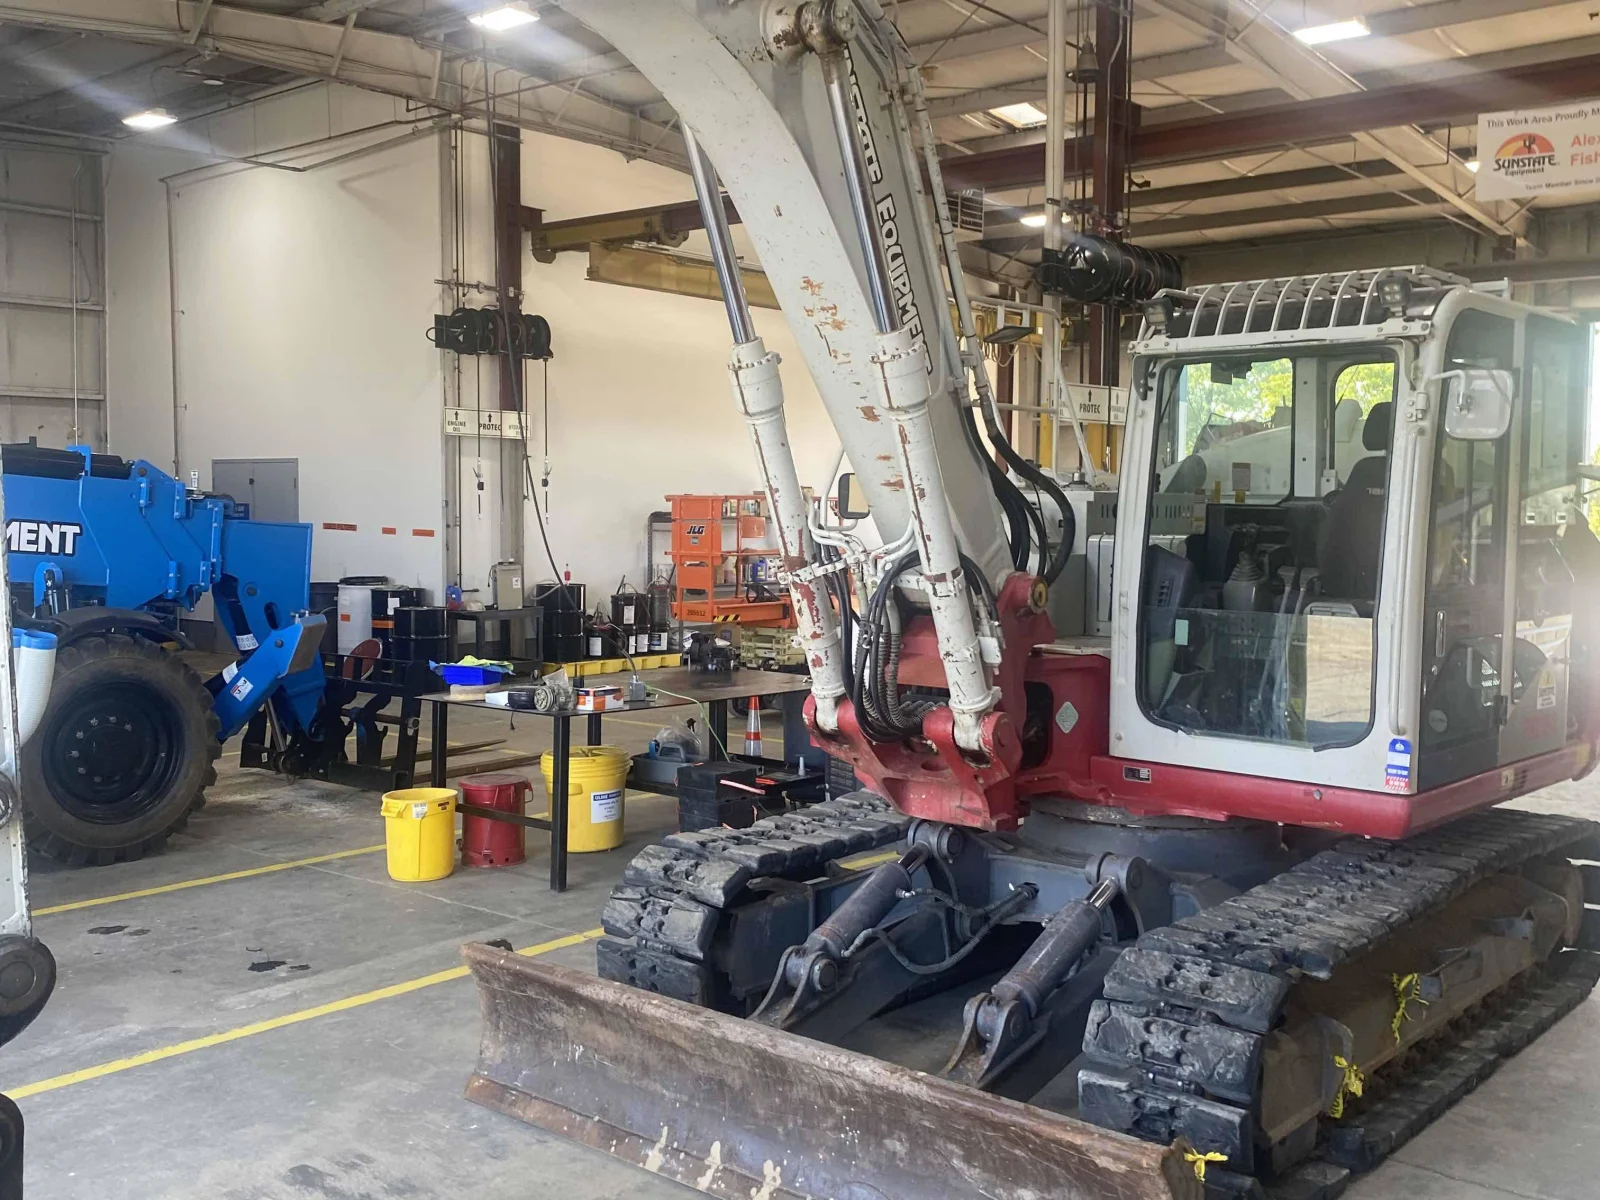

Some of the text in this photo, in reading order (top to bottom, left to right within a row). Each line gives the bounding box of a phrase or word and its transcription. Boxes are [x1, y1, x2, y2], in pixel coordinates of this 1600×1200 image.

[1487, 119, 1504, 128] This
[1506, 117, 1528, 126] Work
[1531, 115, 1552, 124] Area
[1555, 109, 1589, 119] Proudly
[1493, 155, 1556, 172] SUNSTATE
[1505, 167, 1545, 176] Equipment
[1079, 403, 1101, 414] PROTEC
[479, 423, 502, 431] PROTEC
[686, 525, 705, 535] JLG
